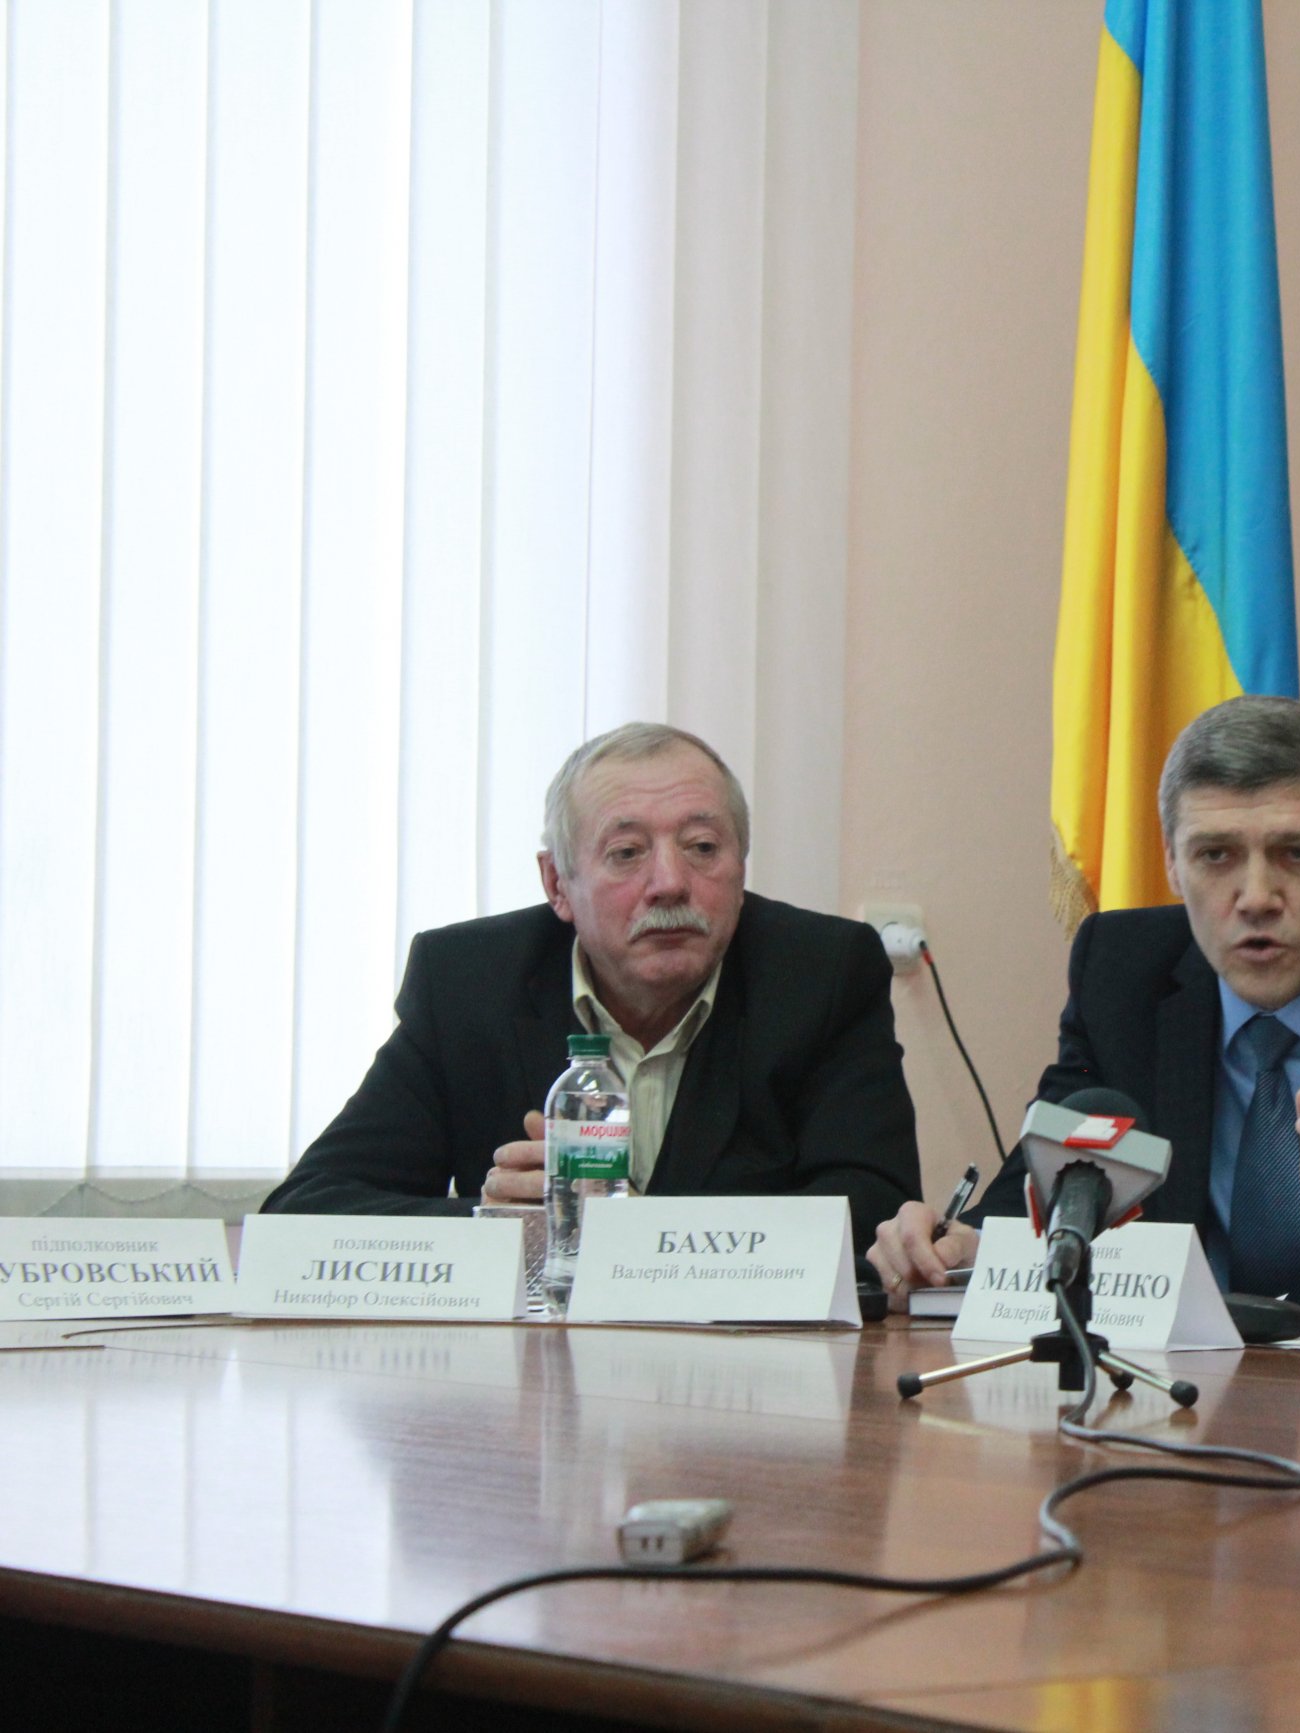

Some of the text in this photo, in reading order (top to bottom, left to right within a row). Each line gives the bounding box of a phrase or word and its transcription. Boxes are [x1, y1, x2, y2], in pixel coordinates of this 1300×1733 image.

[32, 1236, 159, 1253] підполковник
[333, 1237, 435, 1253] полковник
[657, 1231, 767, 1255] БАХУР
[302, 1259, 455, 1285] ЛИСИЦЯ
[612, 1264, 806, 1282] Валерій Анатолійович
[18, 1292, 194, 1309] Сергій Сергійович
[273, 1288, 481, 1309] Никифор Олексійович
[991, 1301, 1051, 1325] Валерій
